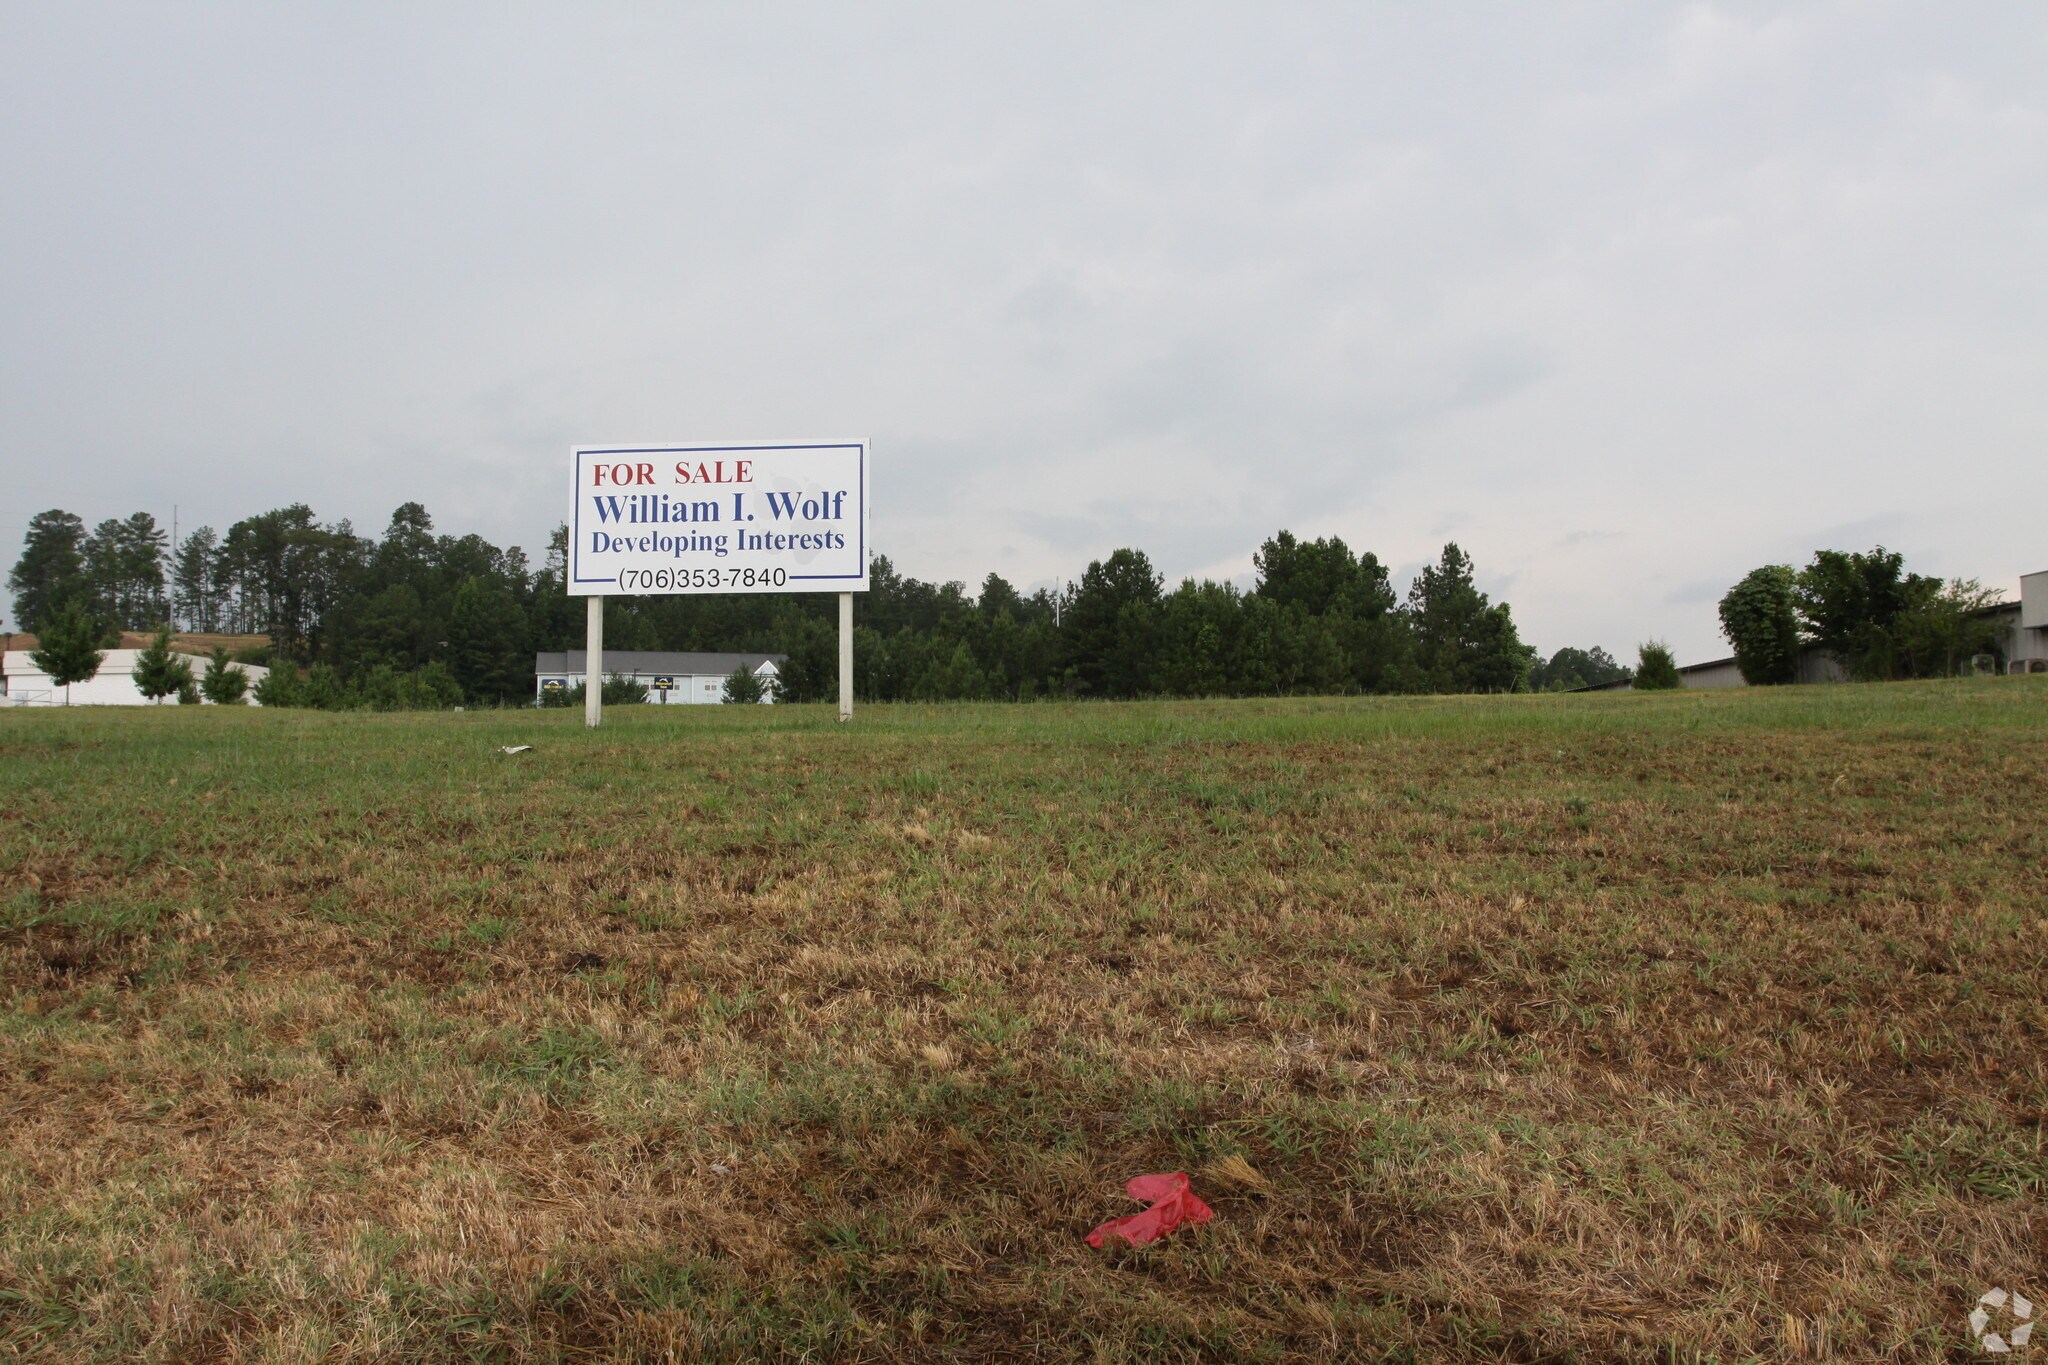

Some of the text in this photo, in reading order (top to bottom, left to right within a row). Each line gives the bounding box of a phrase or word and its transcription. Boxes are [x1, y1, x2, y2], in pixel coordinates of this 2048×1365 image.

[593, 460, 754, 486] FOR SALE
[593, 490, 847, 524] William I. Wolf
[592, 529, 845, 558] Developing Interests
[619, 567, 786, 591] (706)353-7840
